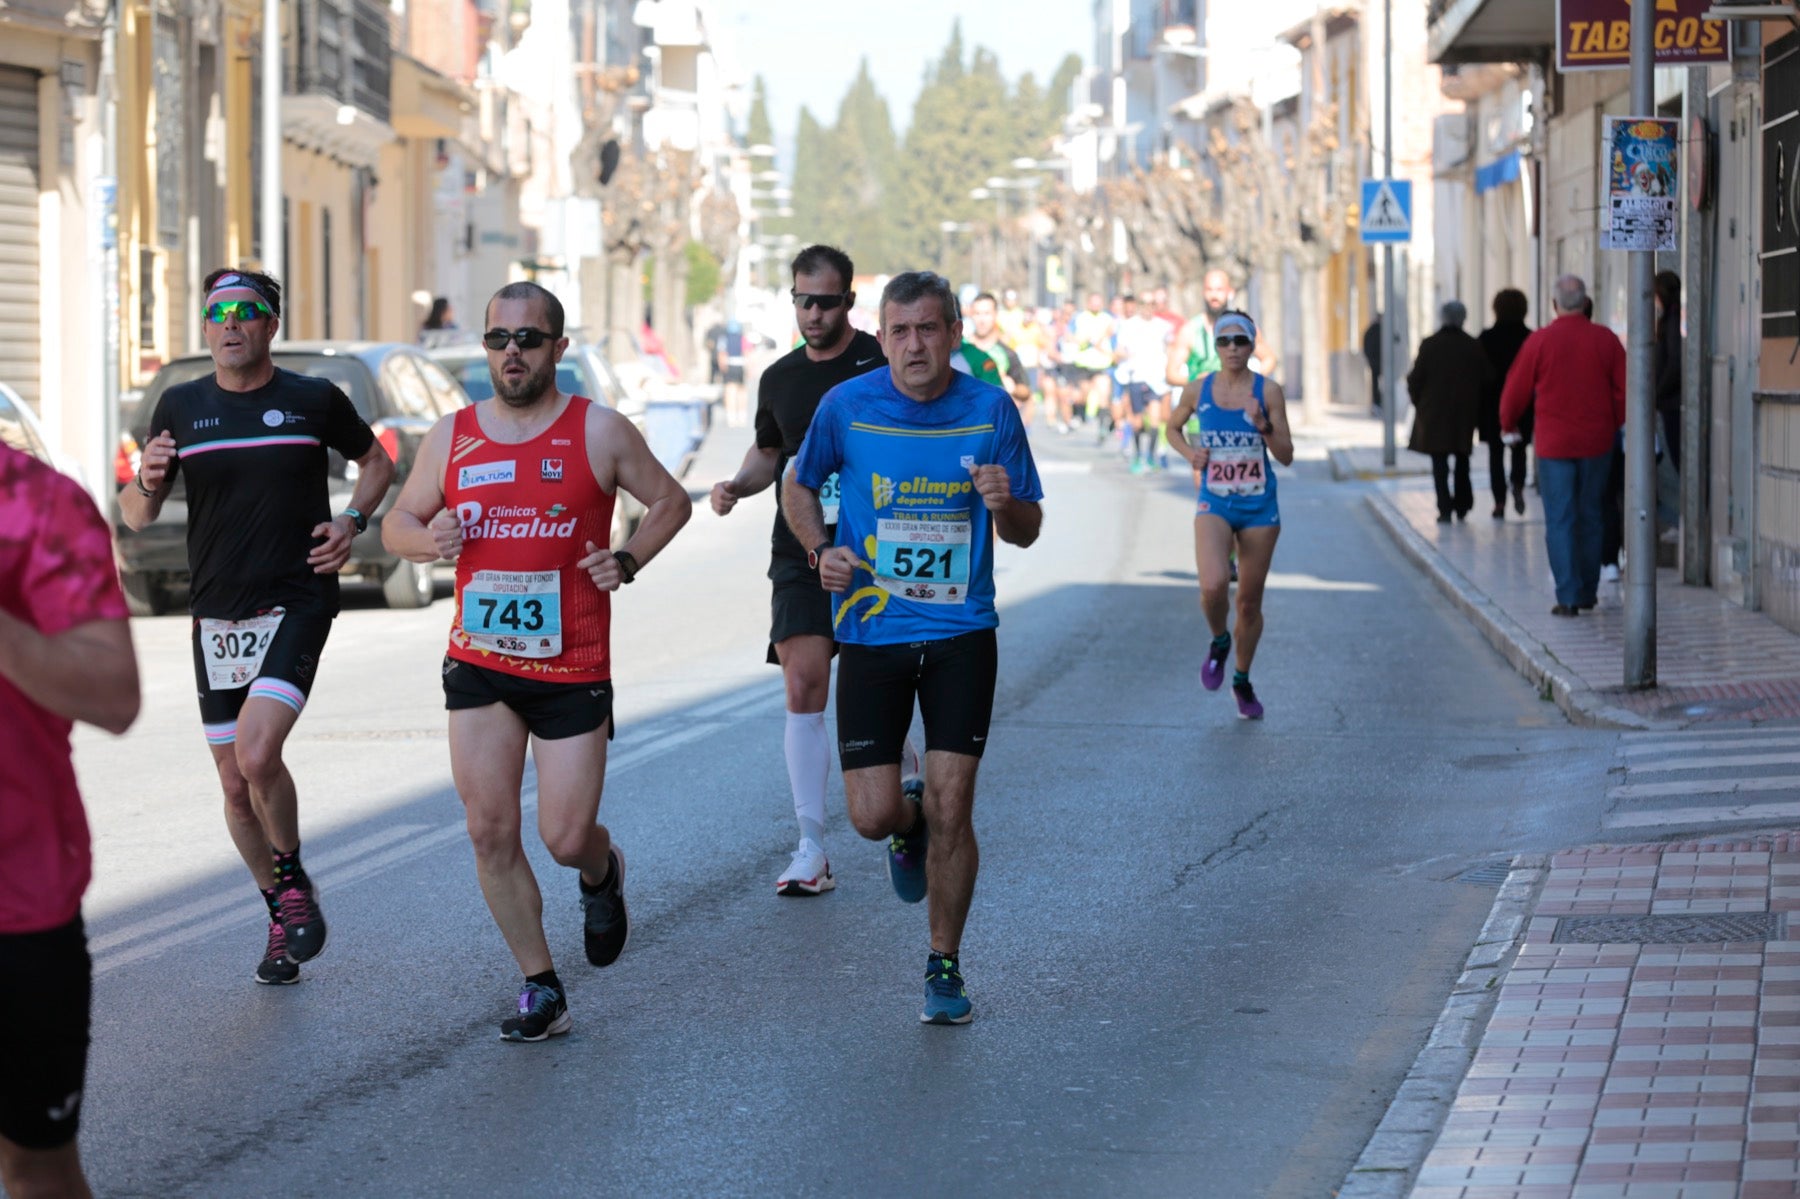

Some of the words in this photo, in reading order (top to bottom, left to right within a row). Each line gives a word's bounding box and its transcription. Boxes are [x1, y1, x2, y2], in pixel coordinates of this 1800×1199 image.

[1569, 17, 1723, 52] TABCOS
[1212, 462, 1261, 481] 2074
[899, 476, 972, 498] olimpo
[488, 505, 537, 518] Clínicas
[896, 496, 944, 507] deportes
[893, 511, 918, 521] TRAIL
[893, 547, 953, 579] 521
[479, 598, 544, 631] 743
